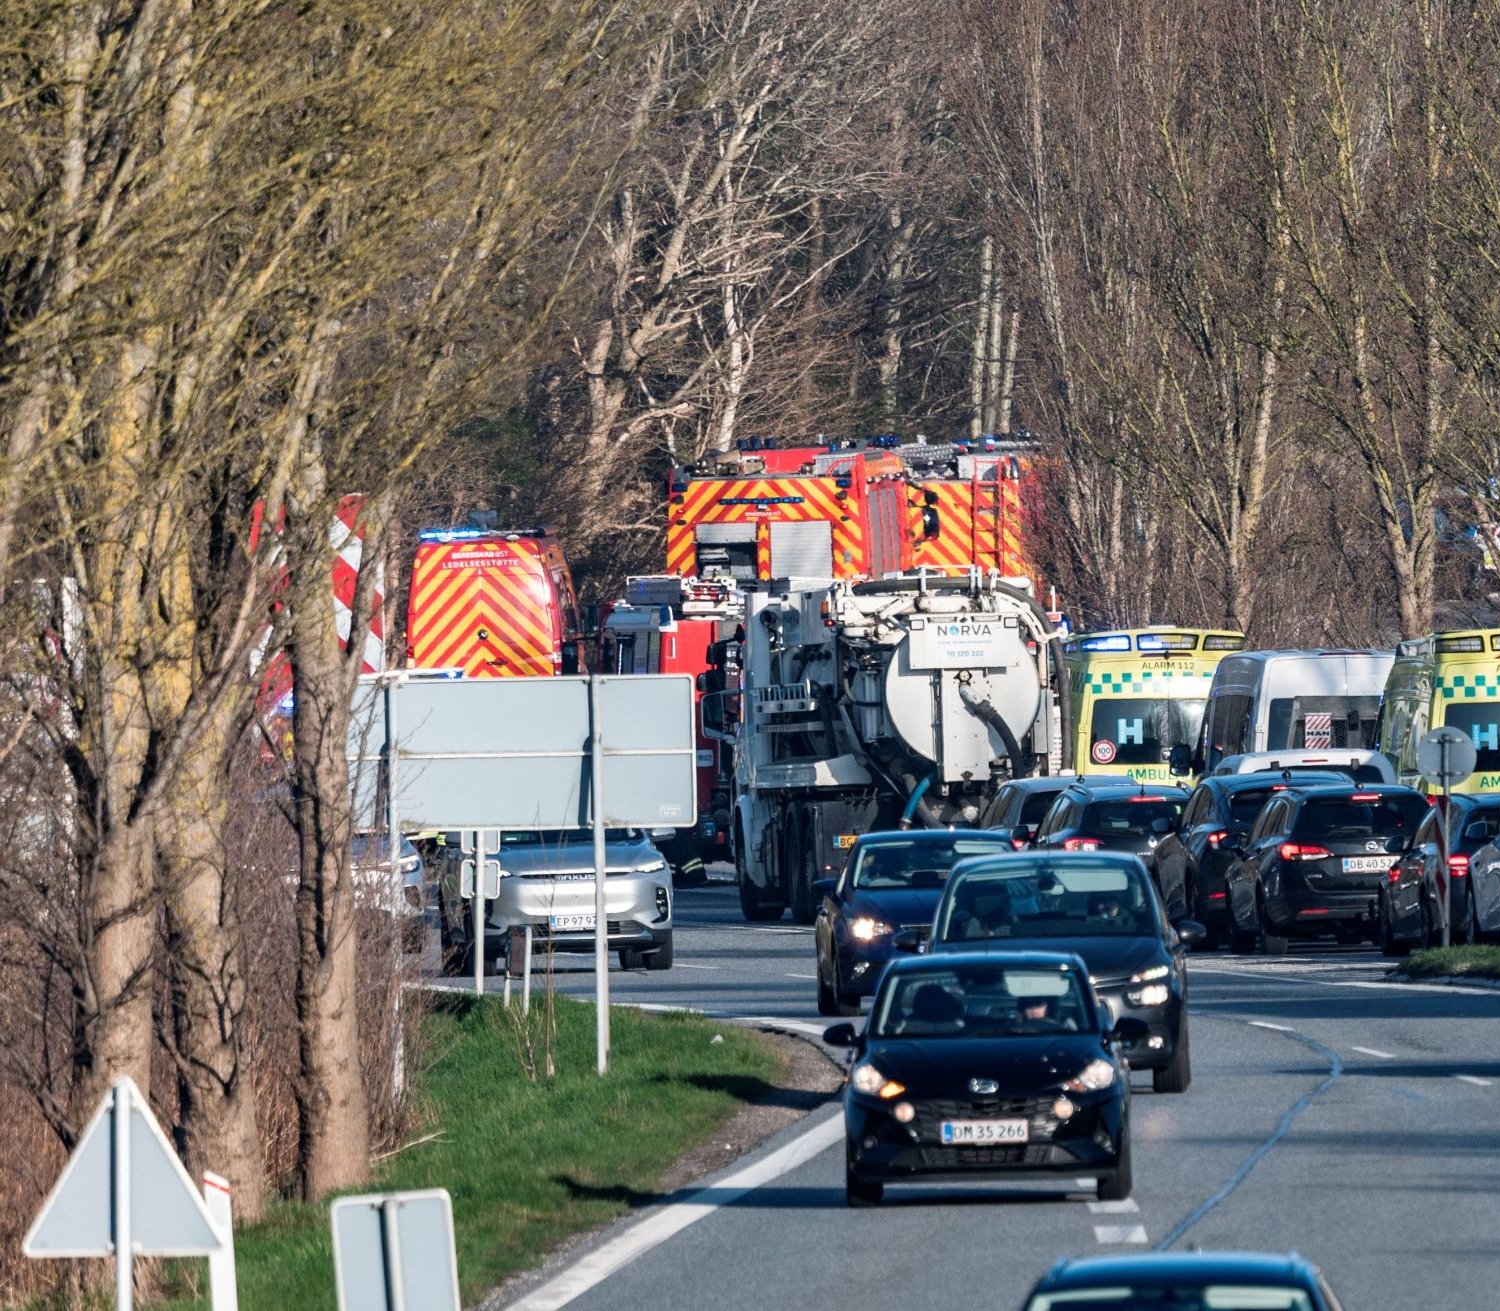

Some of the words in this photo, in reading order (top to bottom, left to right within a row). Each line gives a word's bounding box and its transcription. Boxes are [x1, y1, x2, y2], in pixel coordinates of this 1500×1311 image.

[442, 559, 520, 569] LEDELSESSTØTTE
[937, 624, 992, 637] NORVA
[946, 650, 955, 658] 70
[957, 650, 970, 658] 120
[1142, 661, 1176, 670] ALARM
[1179, 661, 1195, 670] 112
[1097, 747, 1111, 755] 100
[1126, 769, 1177, 780] AMBUL
[1350, 860, 1364, 869] DB
[1366, 859, 1378, 869] 40
[953, 1125, 974, 1140] DM
[977, 1125, 995, 1139] 35
[998, 1124, 1026, 1138] 266
